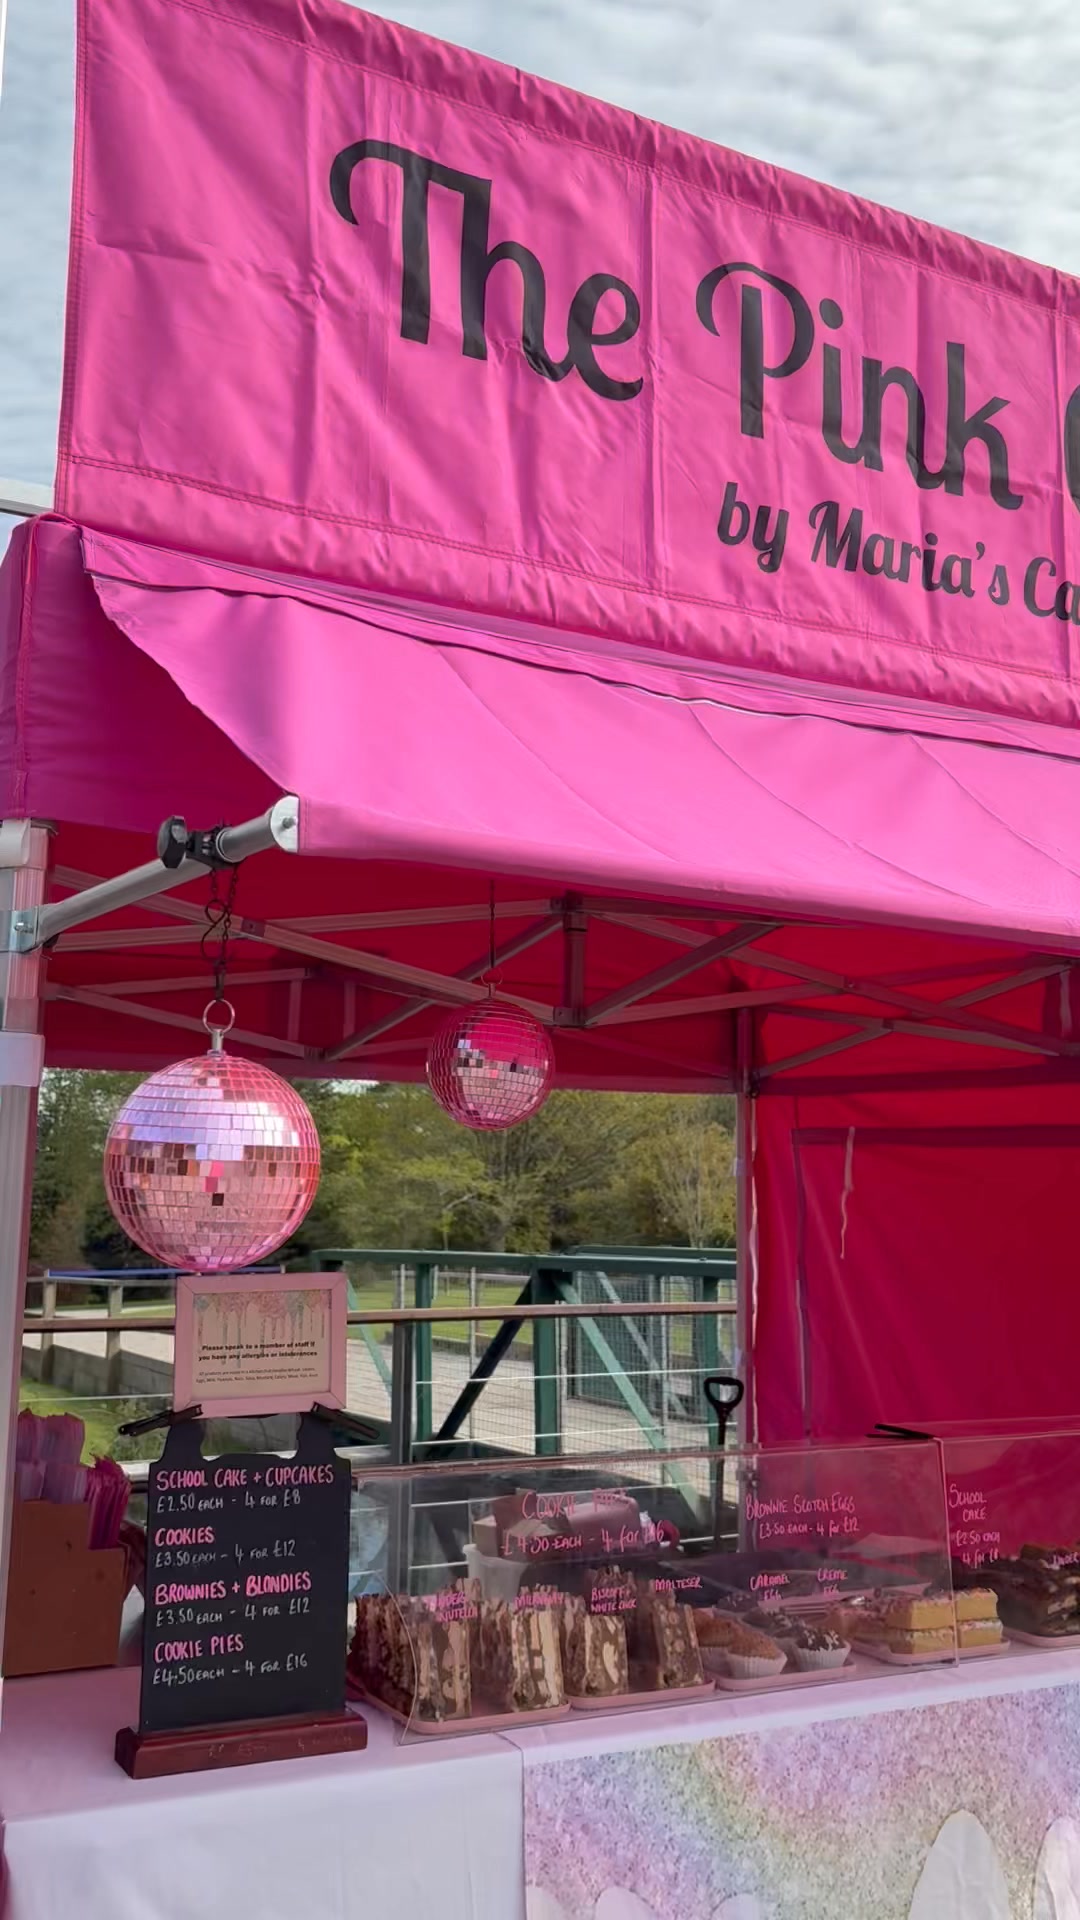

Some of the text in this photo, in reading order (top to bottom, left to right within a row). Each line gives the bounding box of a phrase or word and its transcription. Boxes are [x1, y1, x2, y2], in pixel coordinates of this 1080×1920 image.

[329, 139, 644, 400] The
[696, 262, 1024, 510] Pink
[717, 482, 789, 573] by
[809, 500, 1009, 605] Maria's
[225, 1344, 244, 1352] speak
[156, 1464, 334, 1491] SCHOOL CAKE + CUPCAKES
[156, 1492, 196, 1514] £2.50
[198, 1497, 224, 1511] EACH
[245, 1492, 255, 1509] 4
[260, 1496, 278, 1507] FOR
[283, 1488, 301, 1508] £8
[745, 1491, 856, 1520] BROWNIE SCOTCH EGGS
[949, 1483, 987, 1508] SCHOOL
[816, 1523, 825, 1537] 4
[843, 1516, 860, 1533] £12
[963, 1507, 987, 1522] CAKE
[155, 1526, 215, 1547] COOKIES
[601, 1527, 613, 1552] 4
[620, 1525, 639, 1552] for
[155, 1551, 190, 1568] £3.50
[235, 1544, 244, 1565] 4
[250, 1548, 268, 1559] FOR
[273, 1540, 296, 1558] £12
[962, 1551, 971, 1565] 4
[154, 1571, 312, 1605] BROWNIES + BLONDIES
[156, 1608, 194, 1627] £3.50
[196, 1612, 223, 1625] EACH
[245, 1604, 257, 1620] 4
[262, 1606, 280, 1617] FOR
[289, 1597, 310, 1615] £12
[154, 1634, 244, 1664] COOKIE PIES
[153, 1665, 195, 1687] £4.50
[196, 1668, 225, 1681] EACH
[245, 1660, 255, 1677] 4
[260, 1661, 280, 1674] FOR
[286, 1653, 307, 1672] £16
